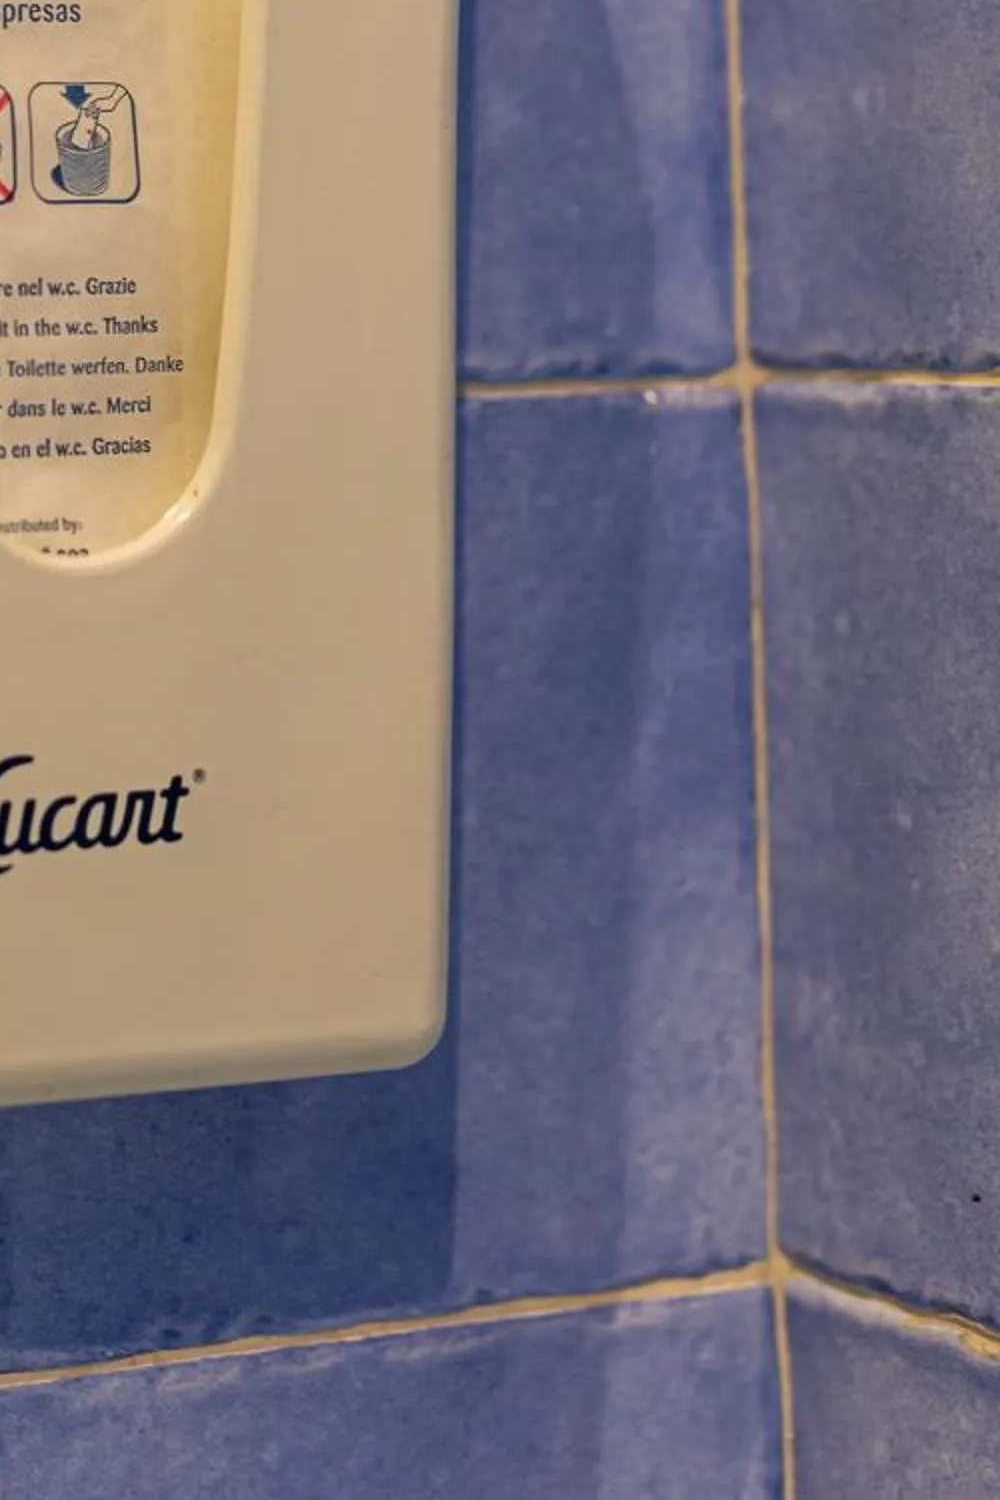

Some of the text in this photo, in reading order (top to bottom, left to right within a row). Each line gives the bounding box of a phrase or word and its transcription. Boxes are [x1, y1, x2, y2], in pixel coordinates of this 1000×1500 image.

[18, 277, 43, 297] nel
[86, 277, 137, 295] Grazie
[14, 318, 29, 337] in
[34, 317, 61, 336] the
[103, 315, 159, 335] Thanks
[7, 358, 66, 378] Toilette
[71, 357, 129, 376] werfen.
[135, 356, 184, 374] Danke
[7, 398, 47, 418] dans
[51, 397, 69, 416] le
[106, 395, 151, 414] Merci
[11, 443, 30, 460] en
[35, 437, 50, 458] el
[92, 435, 152, 456] Gracias
